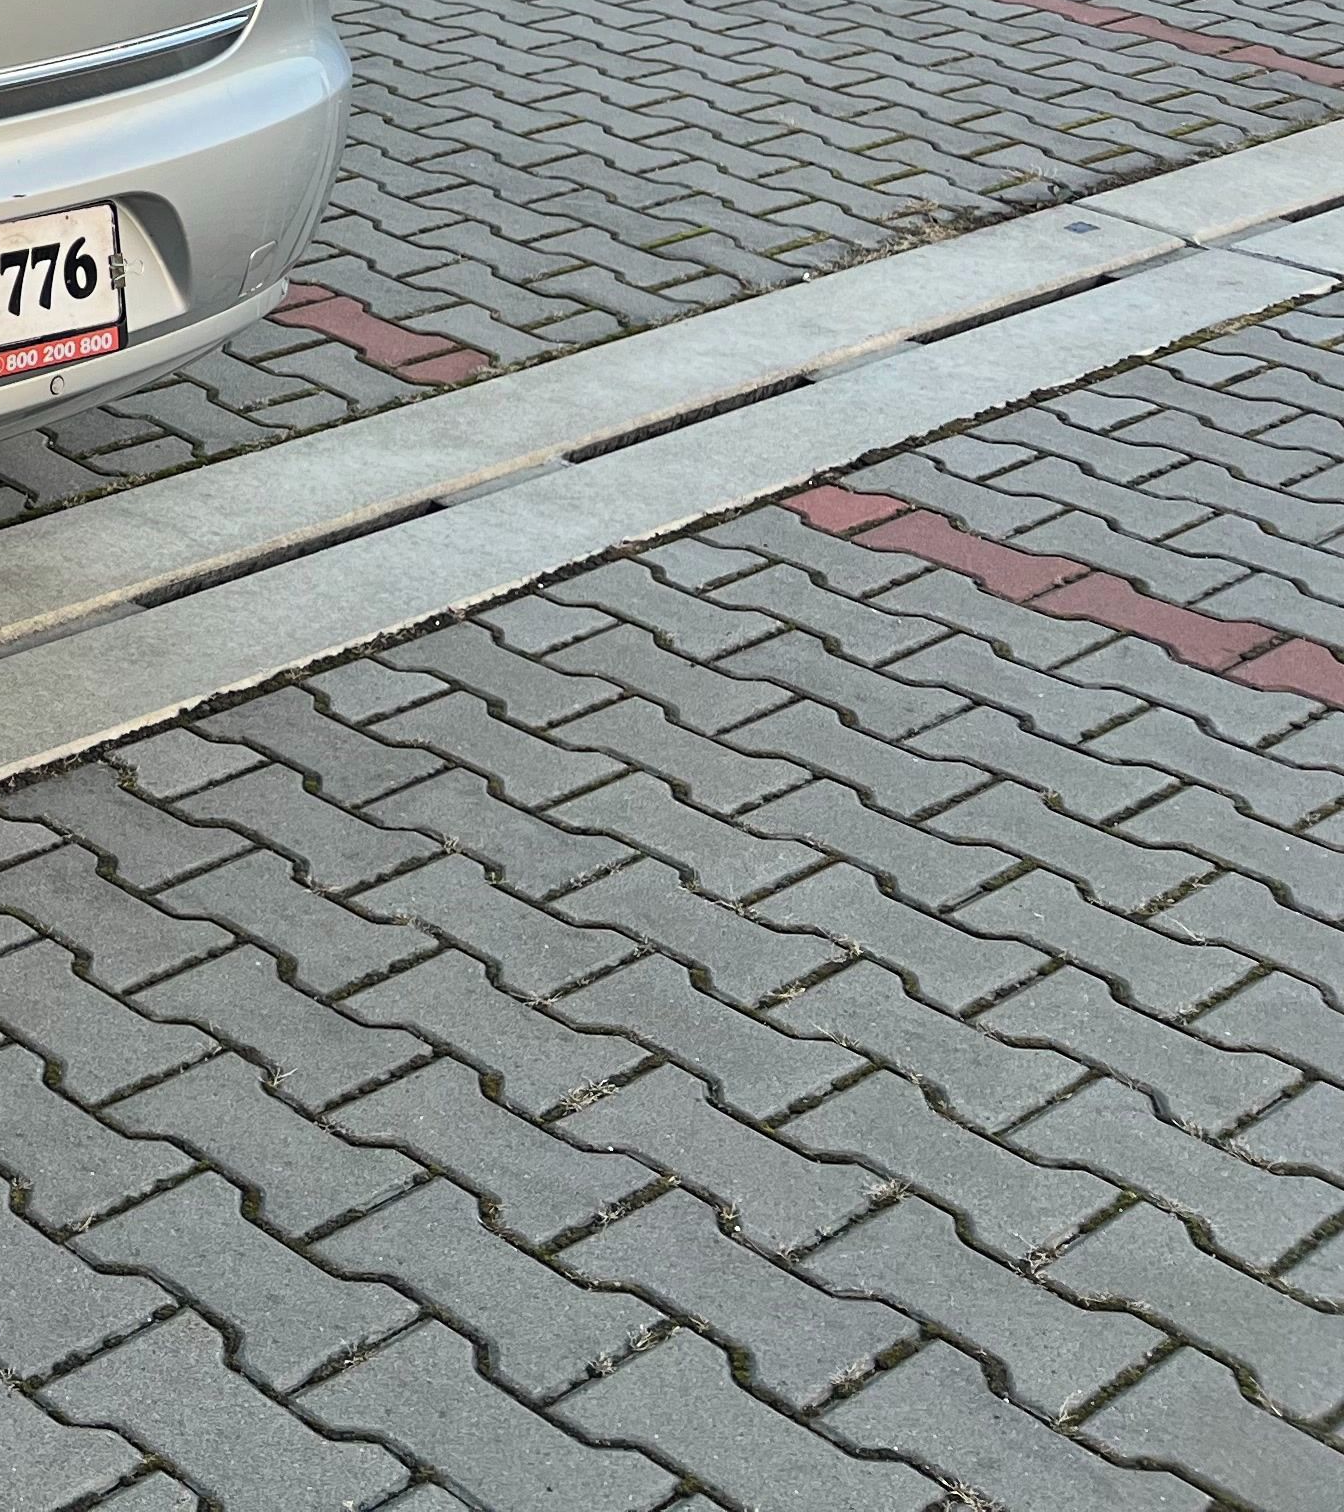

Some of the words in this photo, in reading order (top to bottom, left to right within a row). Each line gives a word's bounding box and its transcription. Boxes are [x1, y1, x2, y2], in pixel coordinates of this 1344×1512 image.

[0, 236, 98, 316] 776
[5, 351, 39, 372] 800
[42, 344, 76, 363] 200
[80, 332, 113, 353] 800
